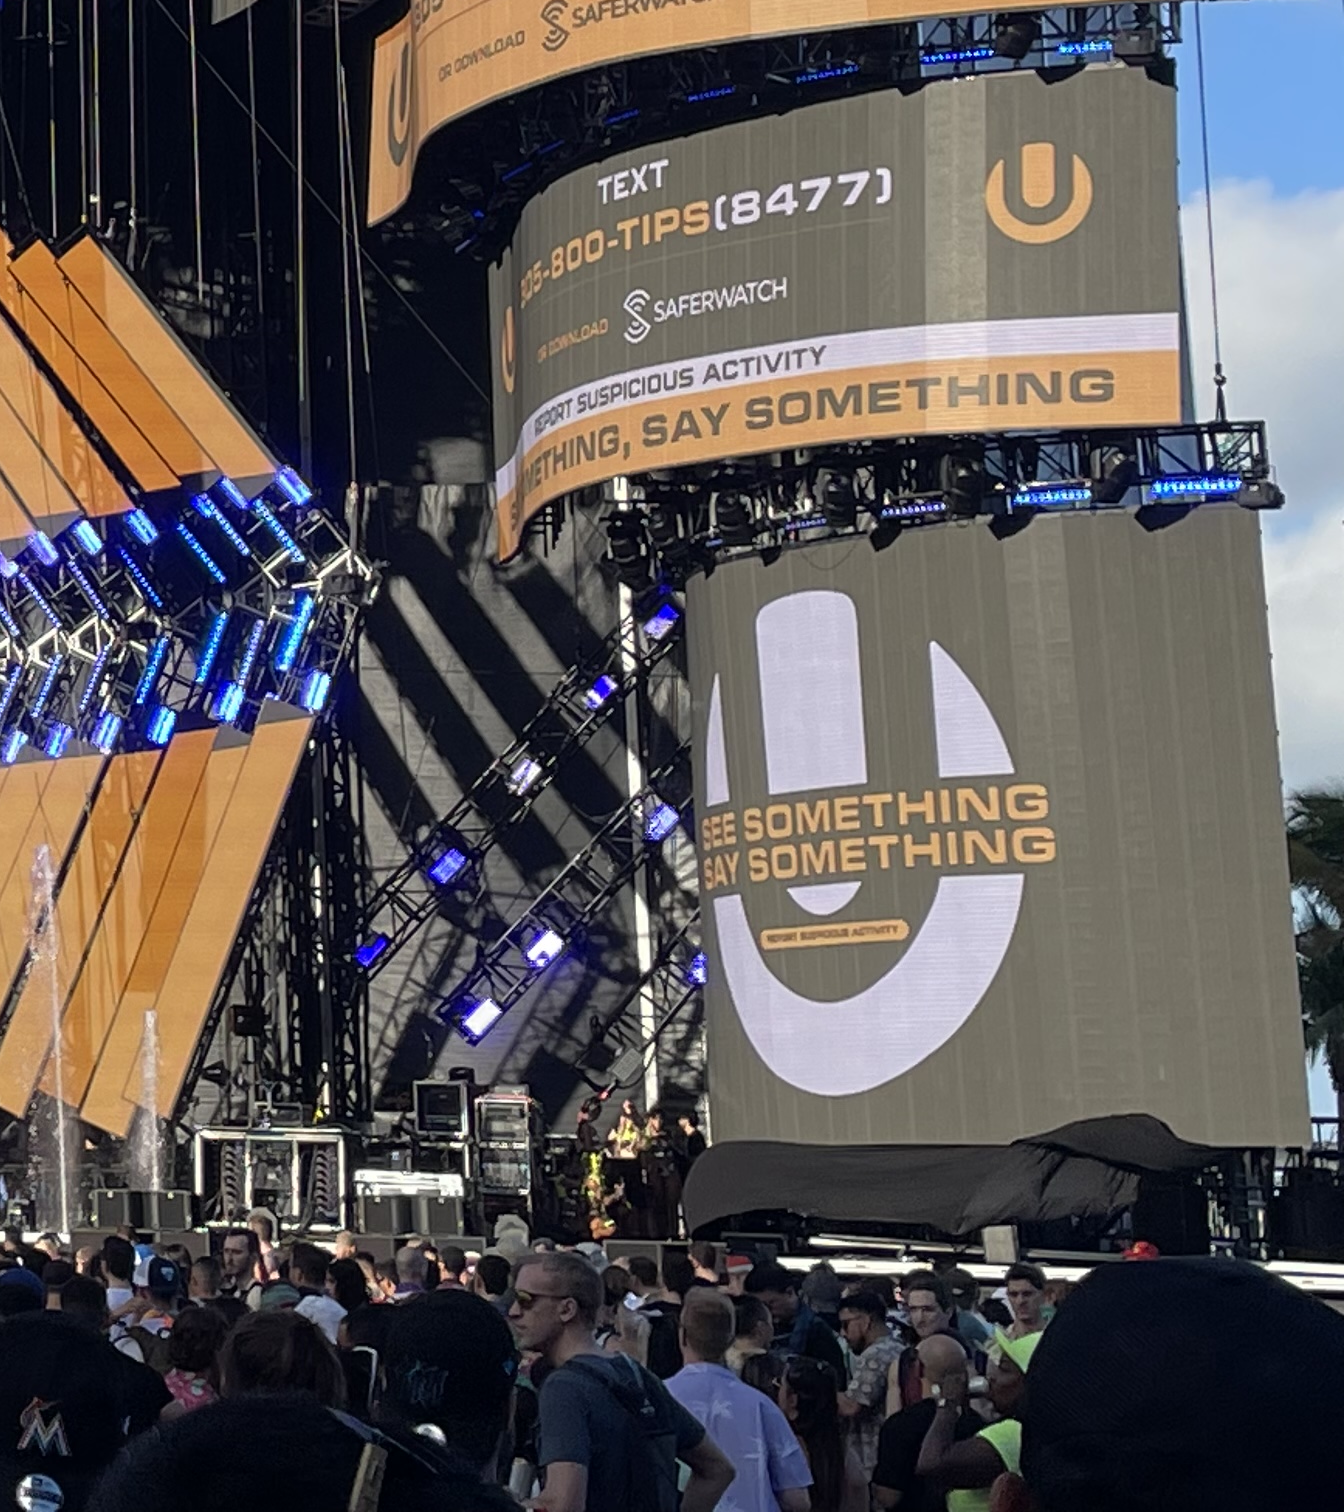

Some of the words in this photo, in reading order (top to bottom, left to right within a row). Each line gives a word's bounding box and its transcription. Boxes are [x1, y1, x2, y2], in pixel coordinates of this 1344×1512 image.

[596, 159, 669, 205] TEXT
[654, 277, 787, 325] SAFERWATCH
[576, 367, 694, 415] SUSPICIOUS
[703, 345, 827, 385] ACTIVITY
[642, 402, 732, 449] SAY
[745, 369, 1116, 431] SOMETHING
[701, 811, 738, 852] SEE
[743, 784, 1049, 844] SOMETHING
[703, 850, 740, 890] SAY
[748, 826, 1057, 883] SOMETHING
